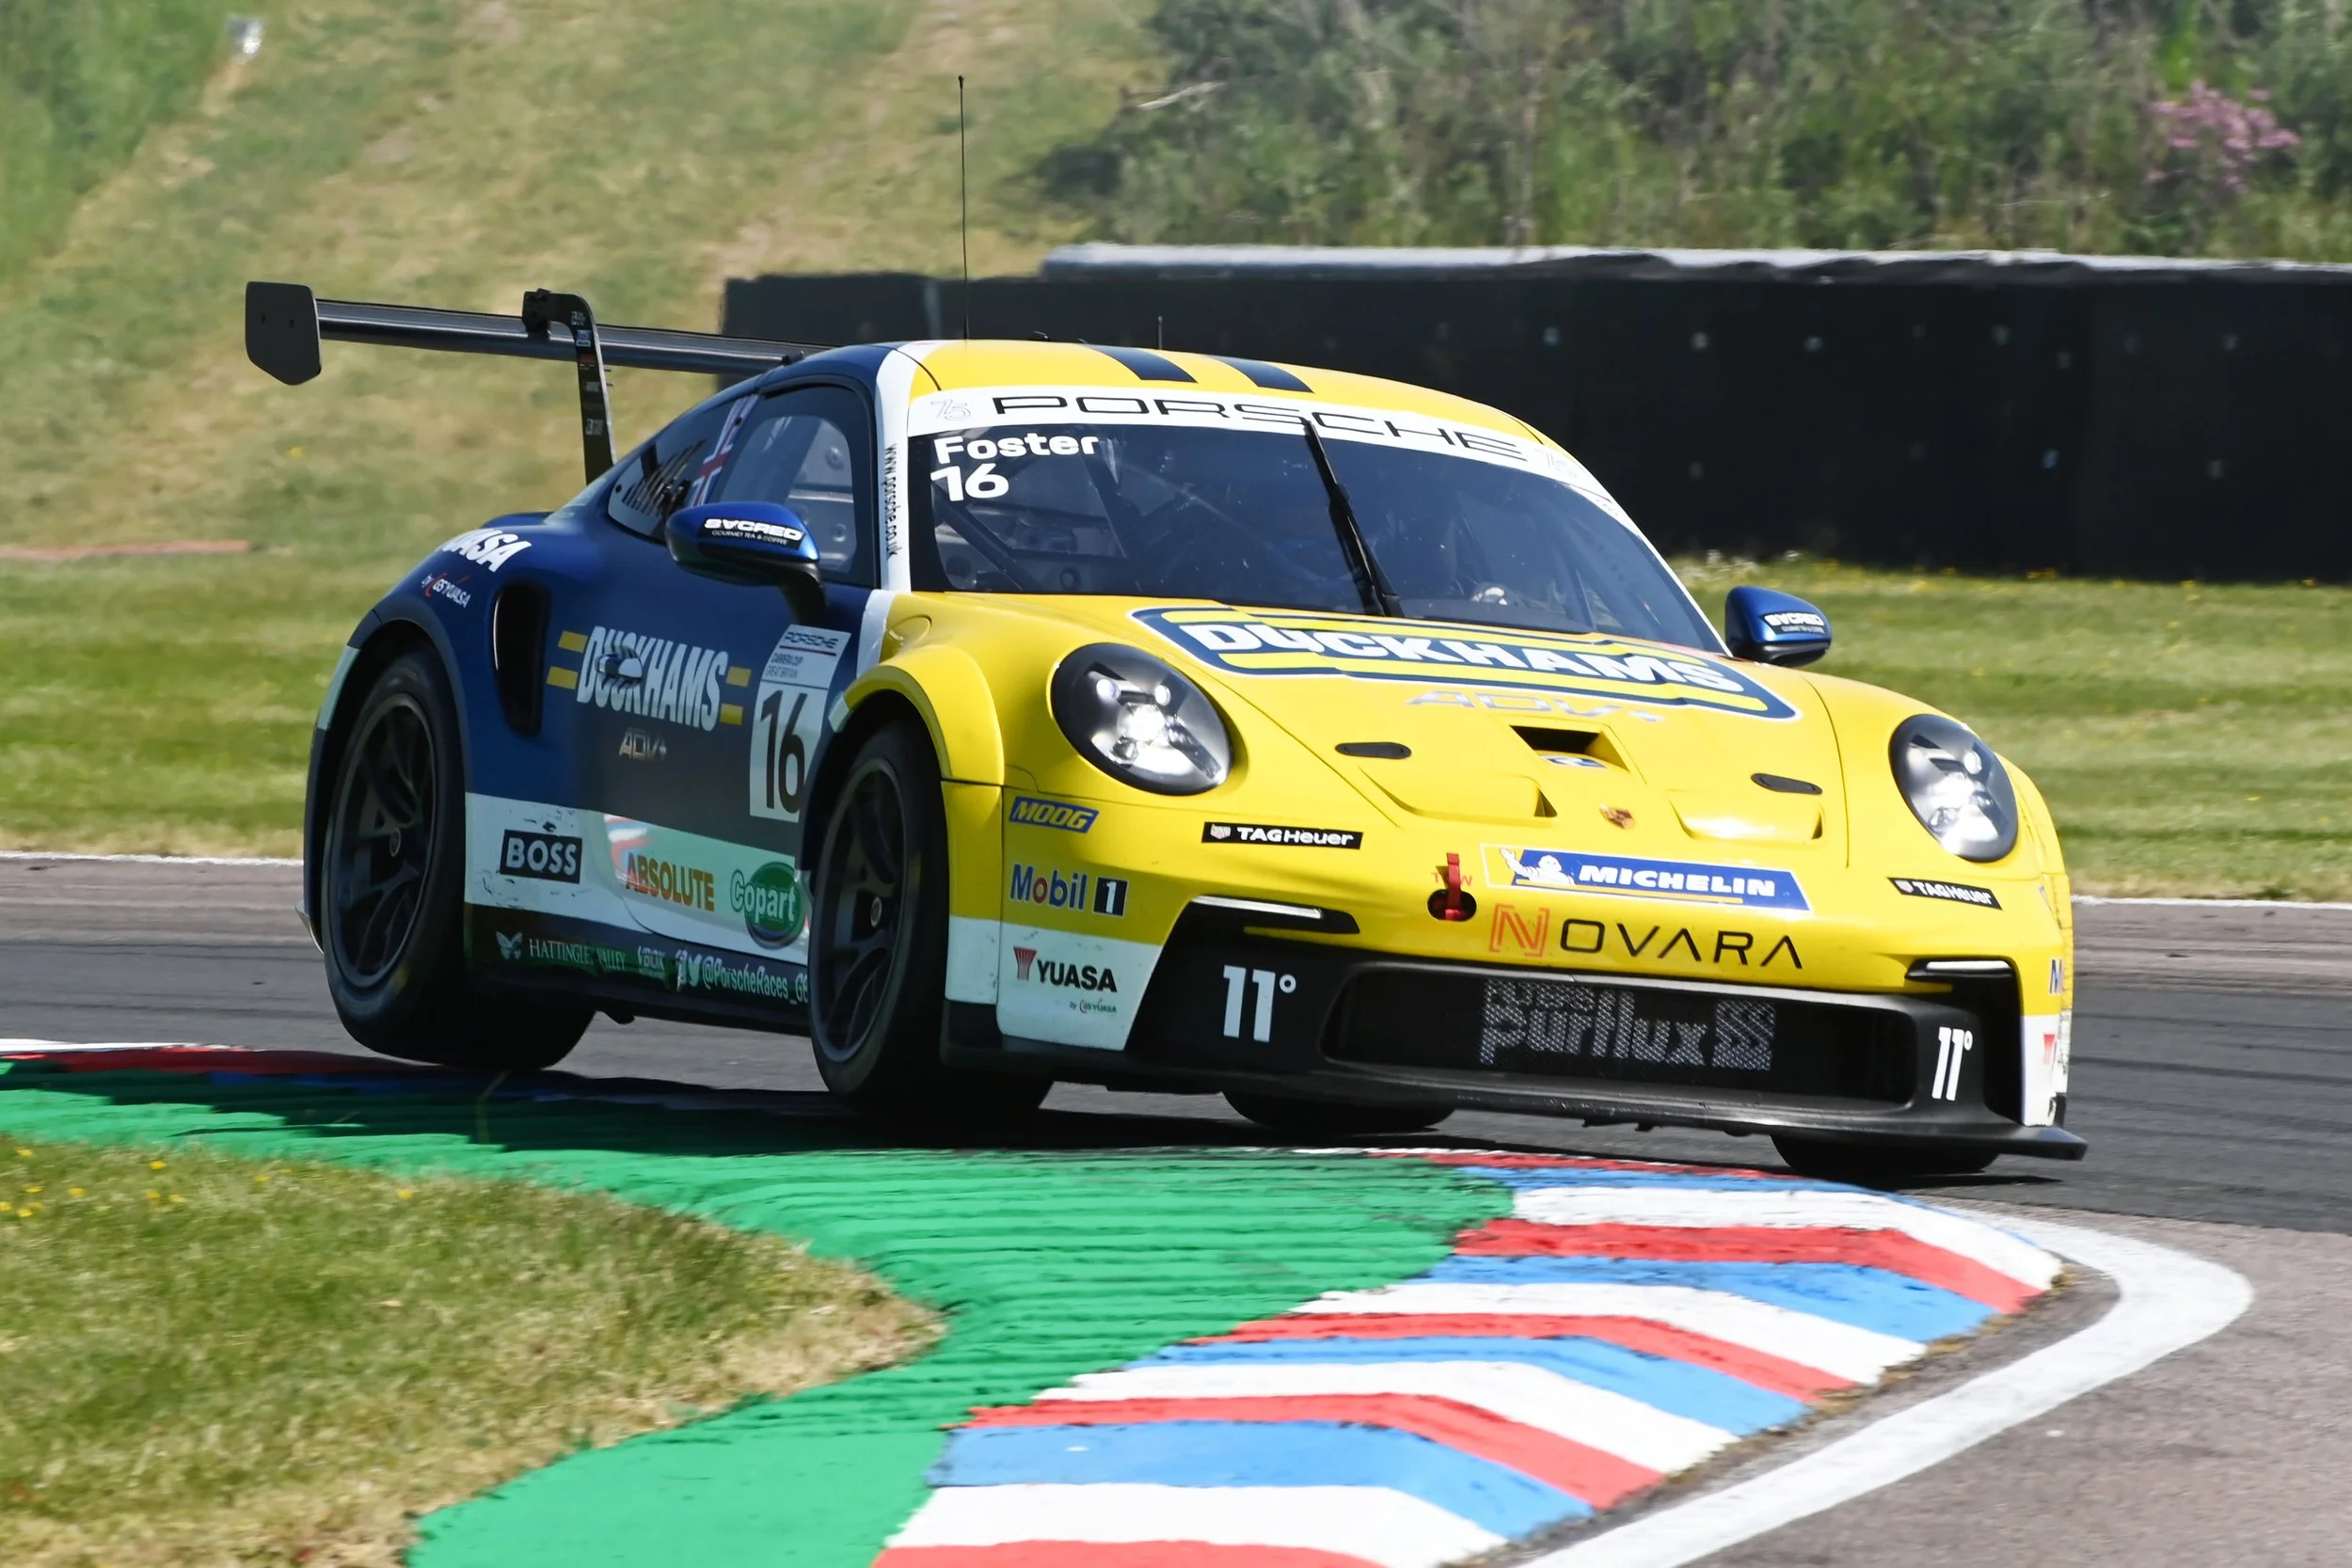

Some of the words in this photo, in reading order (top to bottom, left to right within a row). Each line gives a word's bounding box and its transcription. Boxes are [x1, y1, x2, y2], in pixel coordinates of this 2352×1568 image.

[934, 433, 1099, 465] Foster
[991, 395, 1528, 462] PORSCHE
[930, 463, 1009, 502] 16
[744, 531, 755, 540] TEA
[785, 631, 838, 649] PORSCHE
[1190, 623, 1745, 694] DUCKHAMS
[577, 626, 729, 732] DUCKHAMS
[760, 689, 805, 814] 16
[1012, 800, 1094, 829] MOOG
[506, 837, 577, 876] BOSS
[1431, 871, 1472, 886] TW
[625, 852, 715, 911] ABSOLUTE
[730, 869, 796, 925] Copart
[1009, 862, 1088, 911] Mobil
[1105, 879, 1117, 914] 1
[1579, 863, 1776, 897] MICHELIN
[529, 938, 597, 967] HATTINGLE
[1488, 902, 1803, 970] NOVARA
[1037, 958, 1118, 993] YUASA
[1223, 964, 1296, 1043] 11°
[1931, 1026, 1973, 1101] 11°
